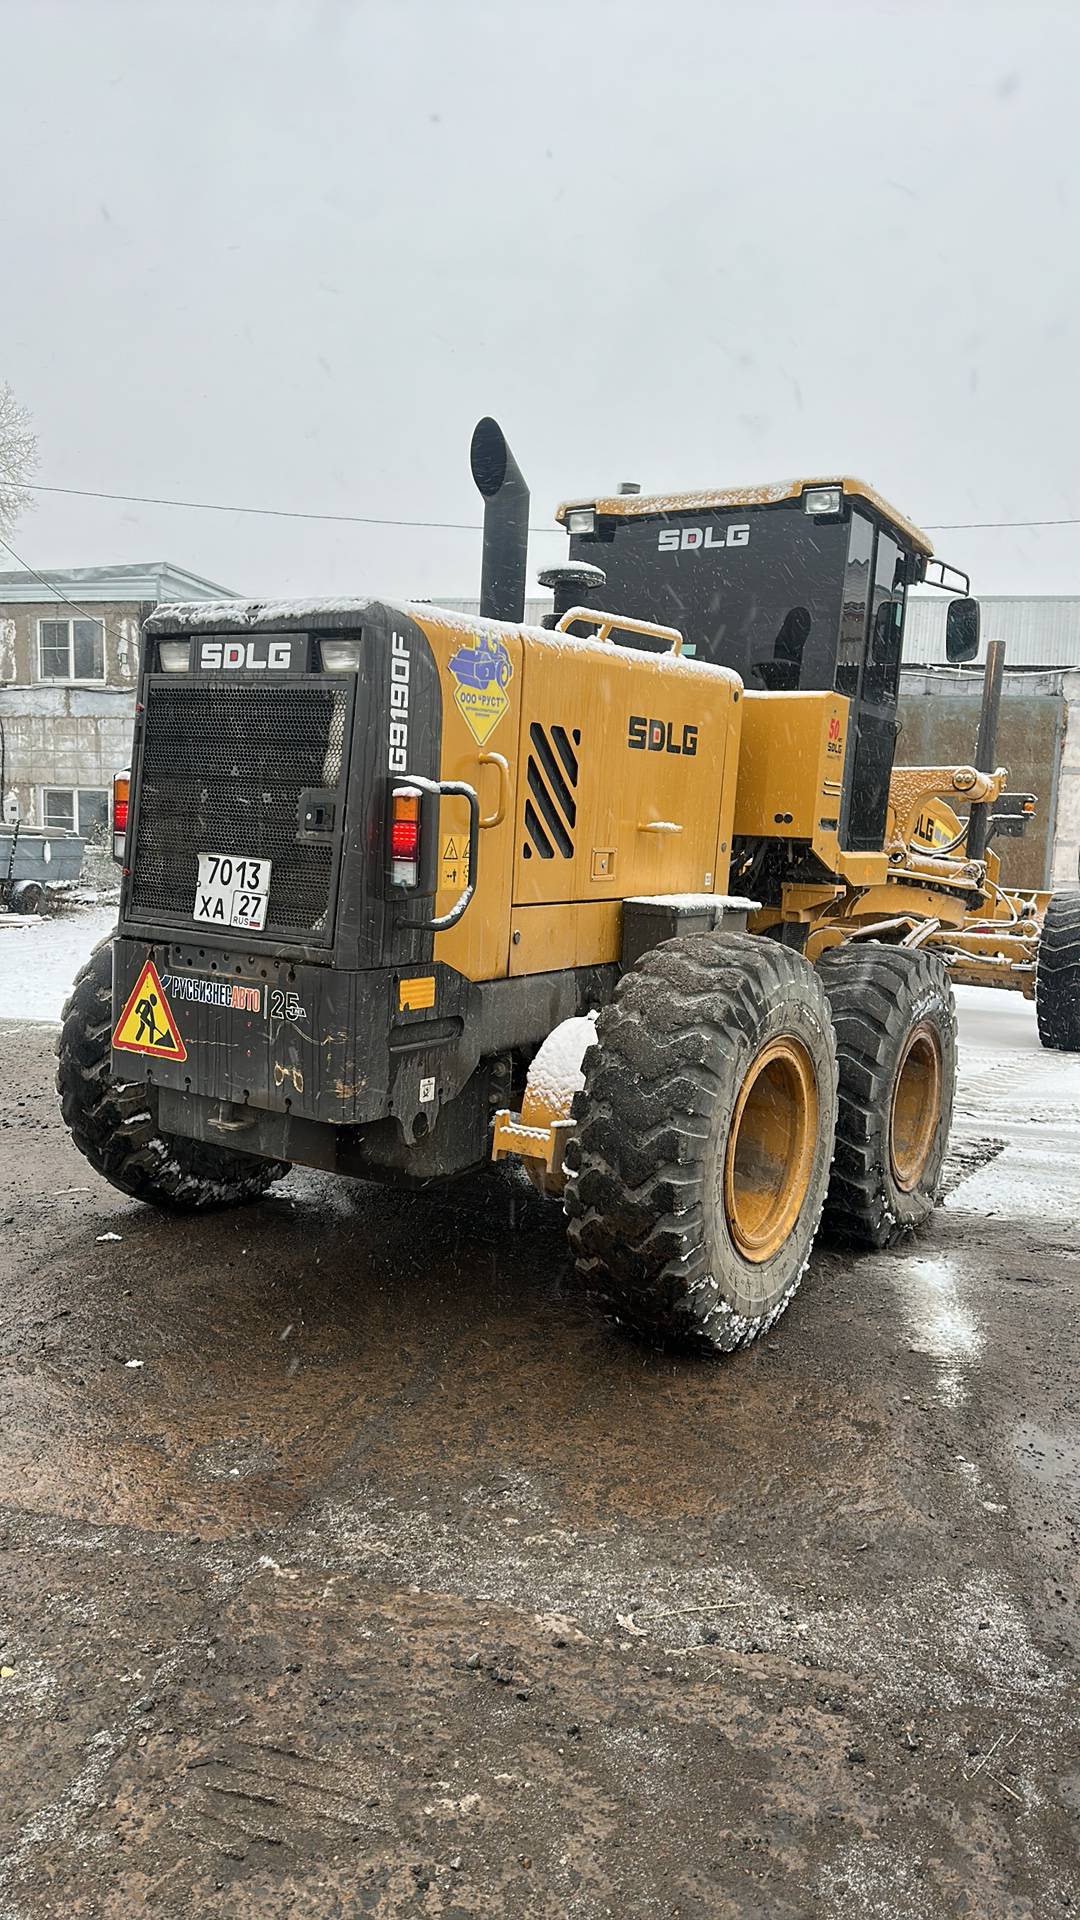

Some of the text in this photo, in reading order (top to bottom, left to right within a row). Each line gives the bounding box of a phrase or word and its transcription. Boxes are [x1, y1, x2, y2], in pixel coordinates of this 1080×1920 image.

[658, 524, 750, 551] SDLG
[201, 643, 291, 669] SDLG
[389, 632, 410, 771] G9190F
[460, 692, 477, 704] ООО
[628, 715, 698, 756] SDLG
[829, 719, 840, 740] 50
[828, 742, 842, 754] SDLG
[208, 857, 261, 890] 7013
[200, 895, 261, 919] ХА 27
[233, 916, 249, 925] RUS
[270, 990, 301, 1020] 25
